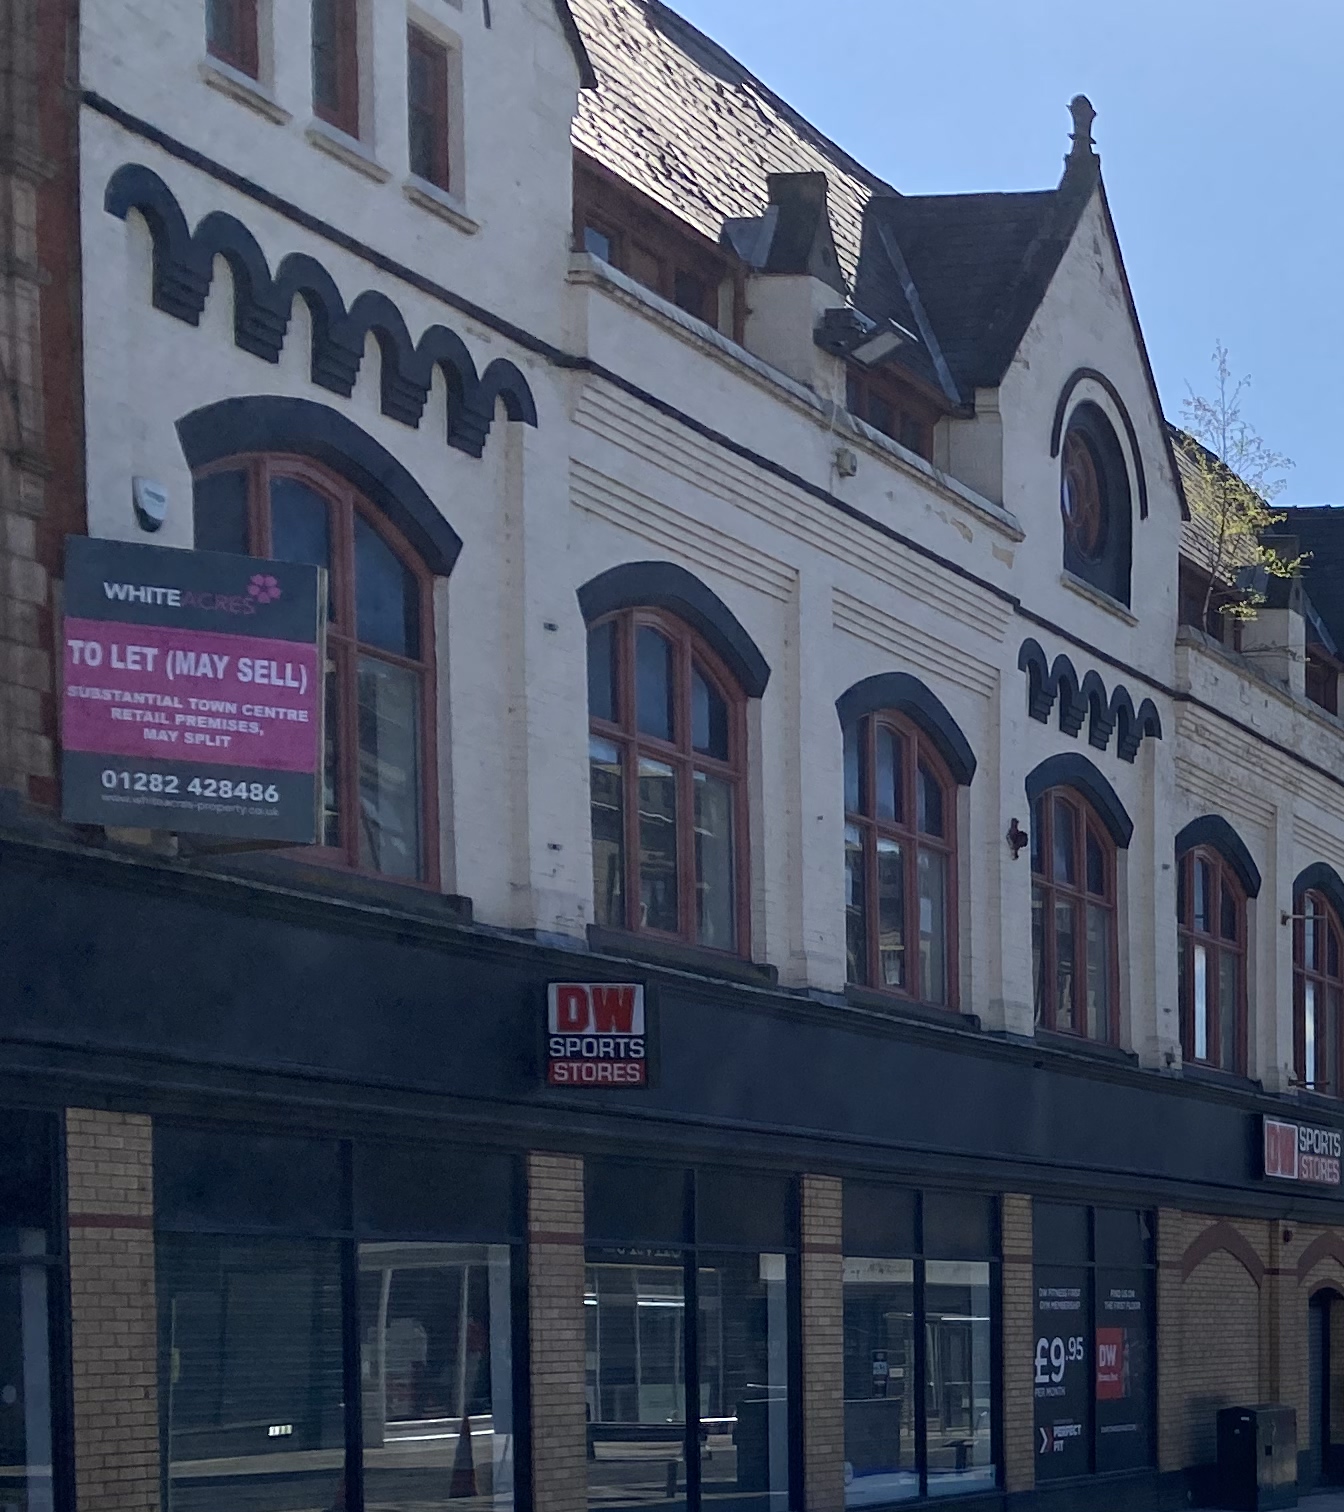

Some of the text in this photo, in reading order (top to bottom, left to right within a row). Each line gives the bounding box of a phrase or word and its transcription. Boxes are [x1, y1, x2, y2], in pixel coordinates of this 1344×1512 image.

[103, 581, 255, 615] WHITEACRES
[67, 639, 307, 694] TO LET (MAY SELL)
[67, 686, 309, 722] SUBSTANTIAL TOWN CENTRE
[111, 707, 264, 735] RETAIL PREMISES,
[143, 727, 232, 748] MAY SPLIT
[101, 770, 280, 803] 01282 428486
[556, 985, 637, 1033] DW
[549, 1038, 645, 1058] SPORTS
[554, 1062, 641, 1082] STORES
[1299, 1126, 1341, 1157] SPORTS
[1301, 1155, 1340, 1183] STORES
[1099, 1344, 1117, 1367] DW
[1034, 1386, 1066, 1397] PER MONTH
